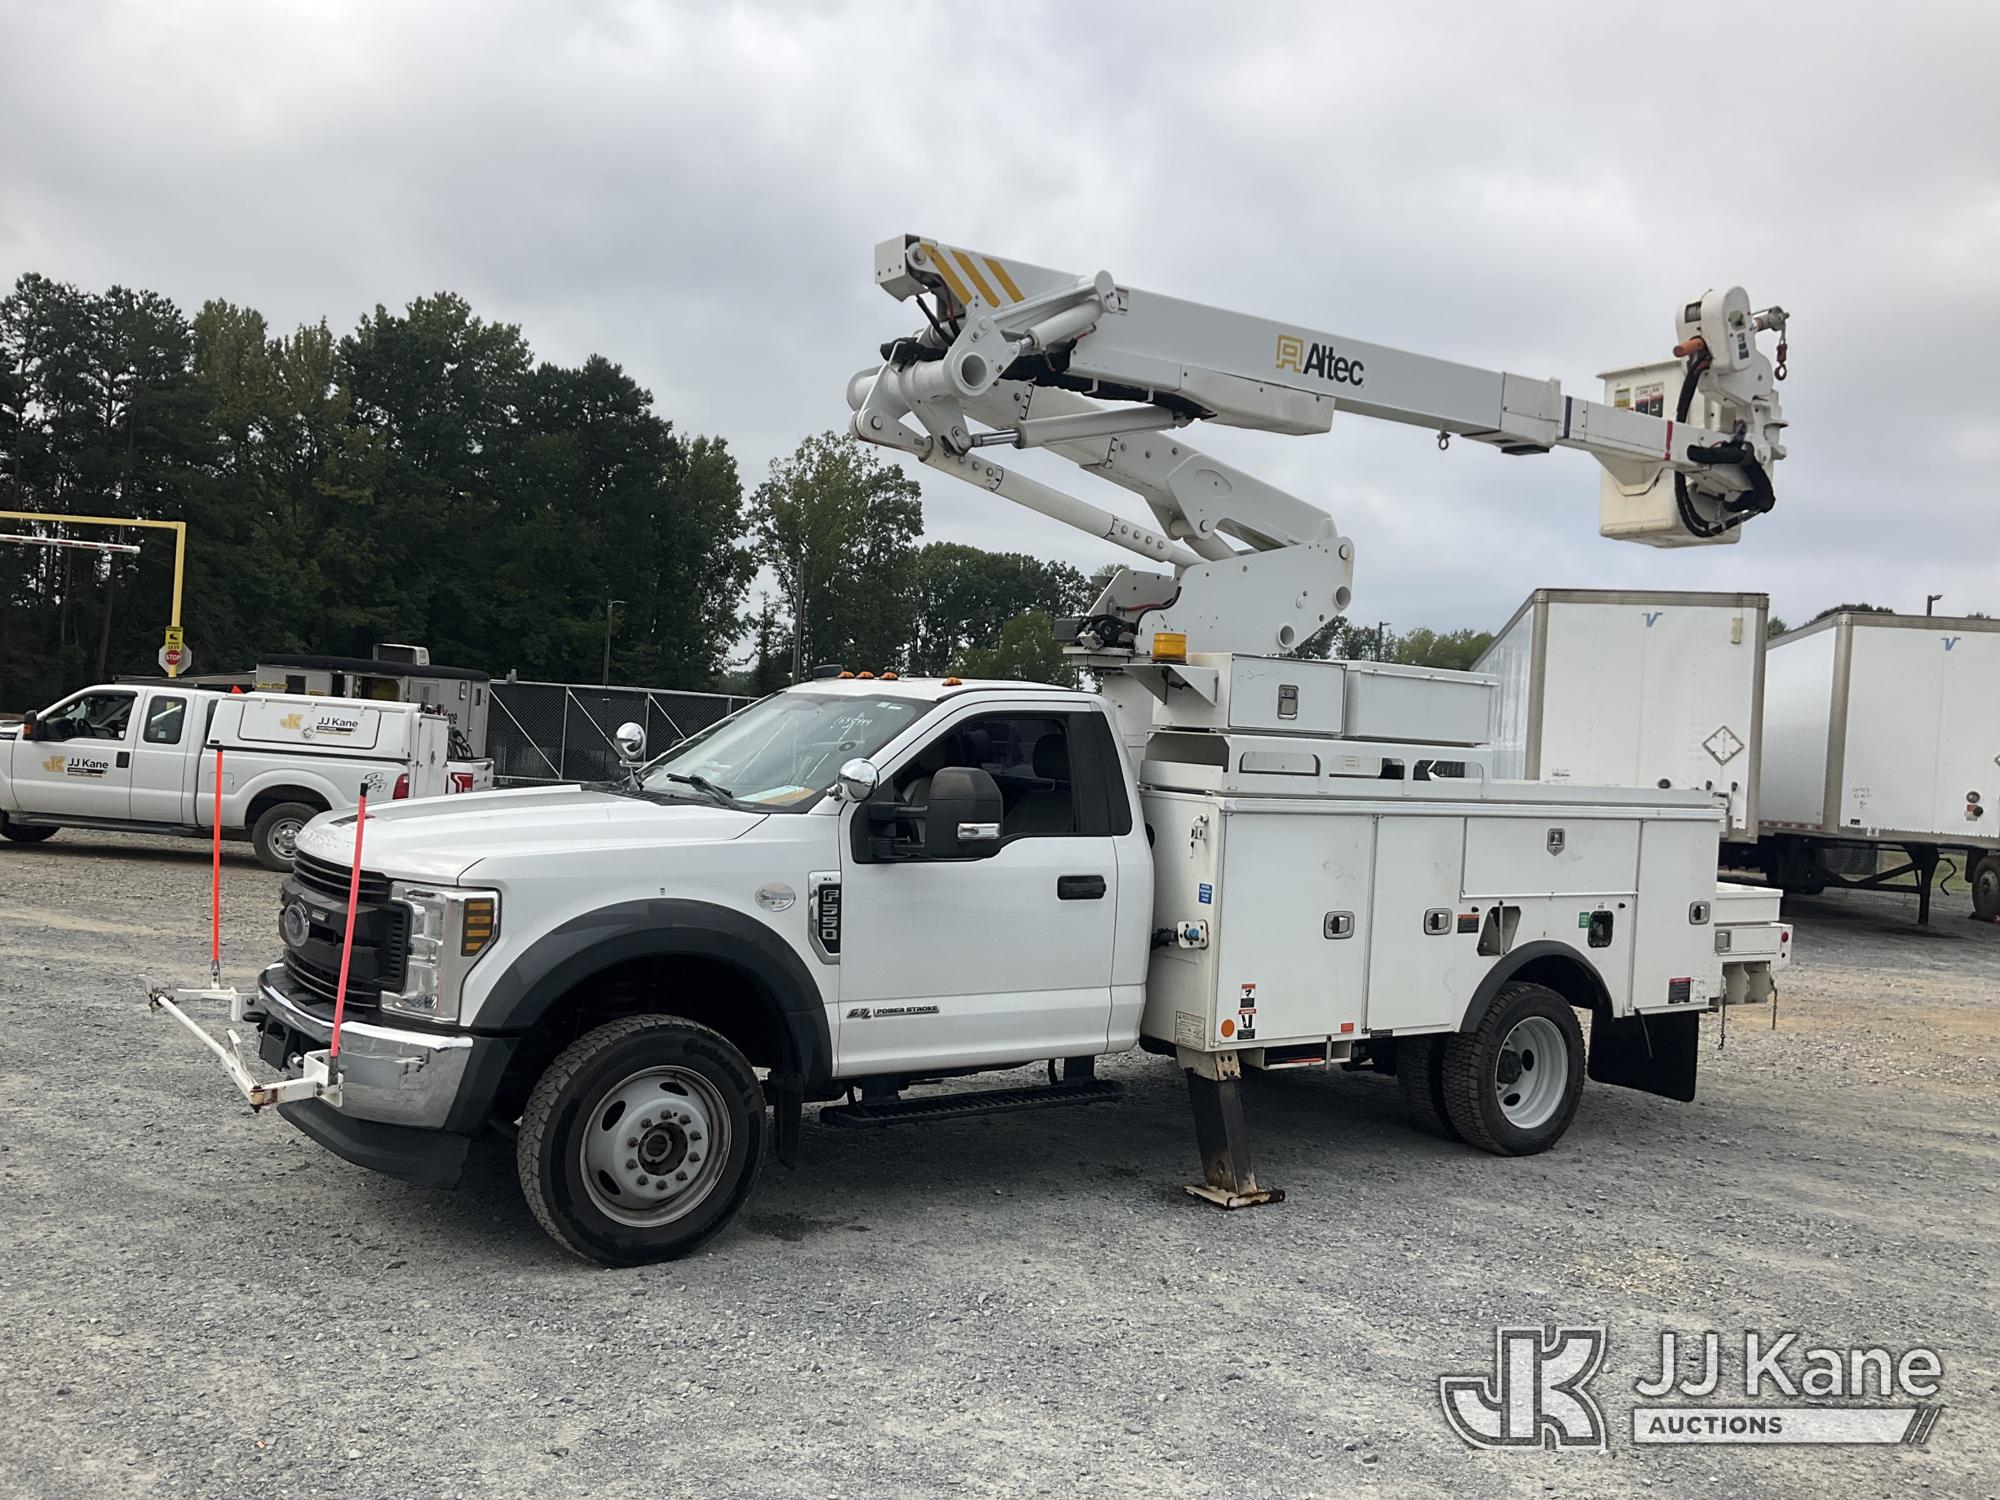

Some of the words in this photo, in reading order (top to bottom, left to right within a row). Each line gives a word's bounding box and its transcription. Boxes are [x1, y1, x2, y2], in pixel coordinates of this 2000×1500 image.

[1303, 342, 1364, 386] Altec
[318, 717, 330, 726] JJ
[331, 717, 359, 728] Kane
[68, 758, 80, 767] JJ
[82, 759, 108, 769] Kane
[906, 1005, 938, 1014] STROKE
